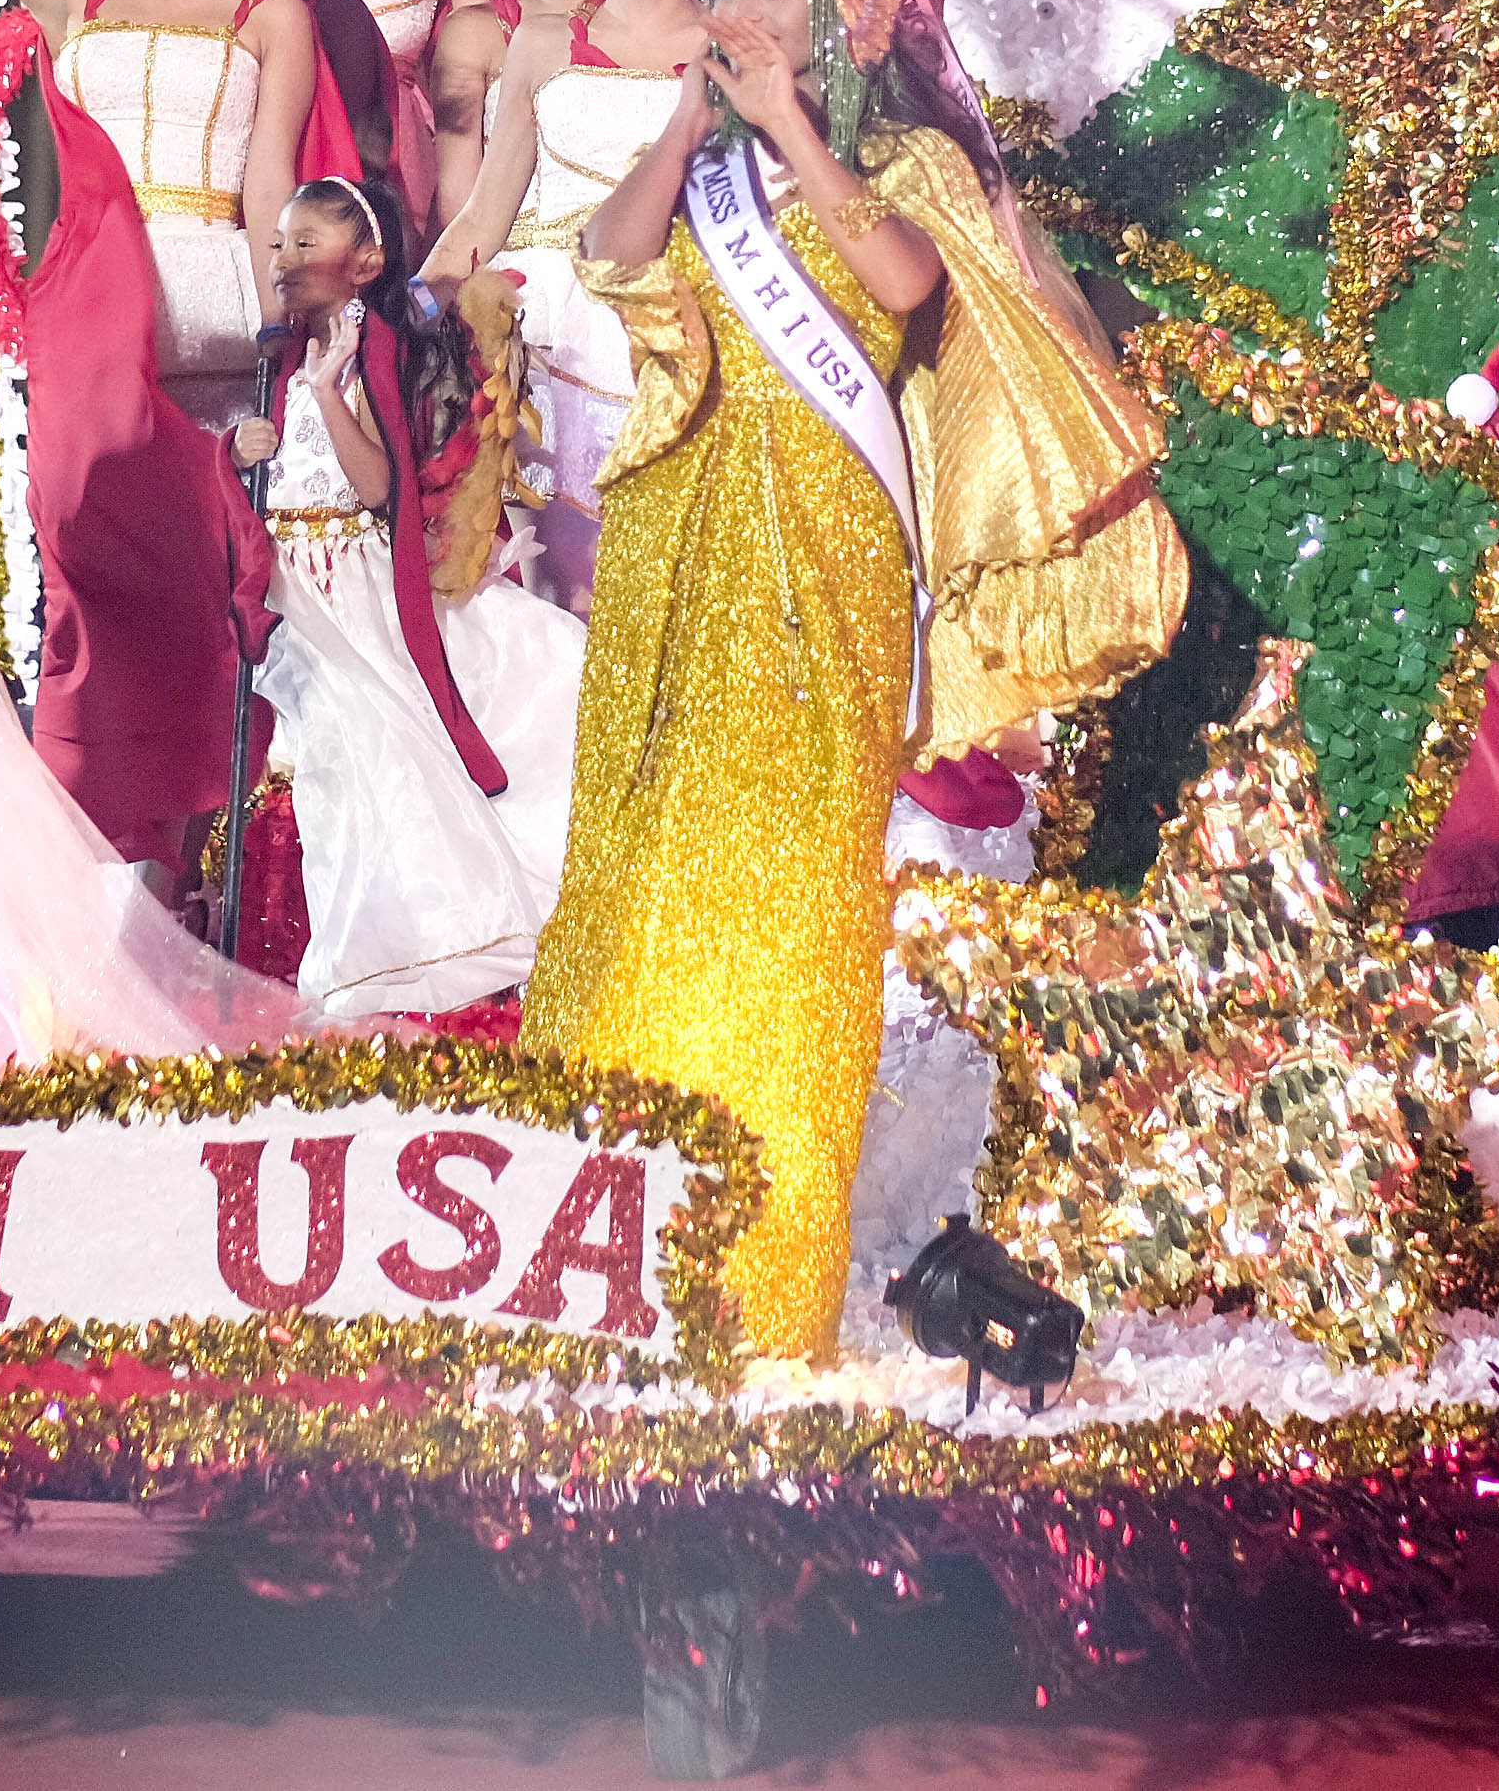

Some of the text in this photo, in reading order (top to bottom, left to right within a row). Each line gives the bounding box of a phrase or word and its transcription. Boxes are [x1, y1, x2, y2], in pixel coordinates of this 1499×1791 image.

[701, 163, 740, 224] MISS
[725, 228, 761, 271] M
[753, 274, 790, 311] H
[805, 337, 864, 410] USA
[200, 1129, 660, 1339] USA
